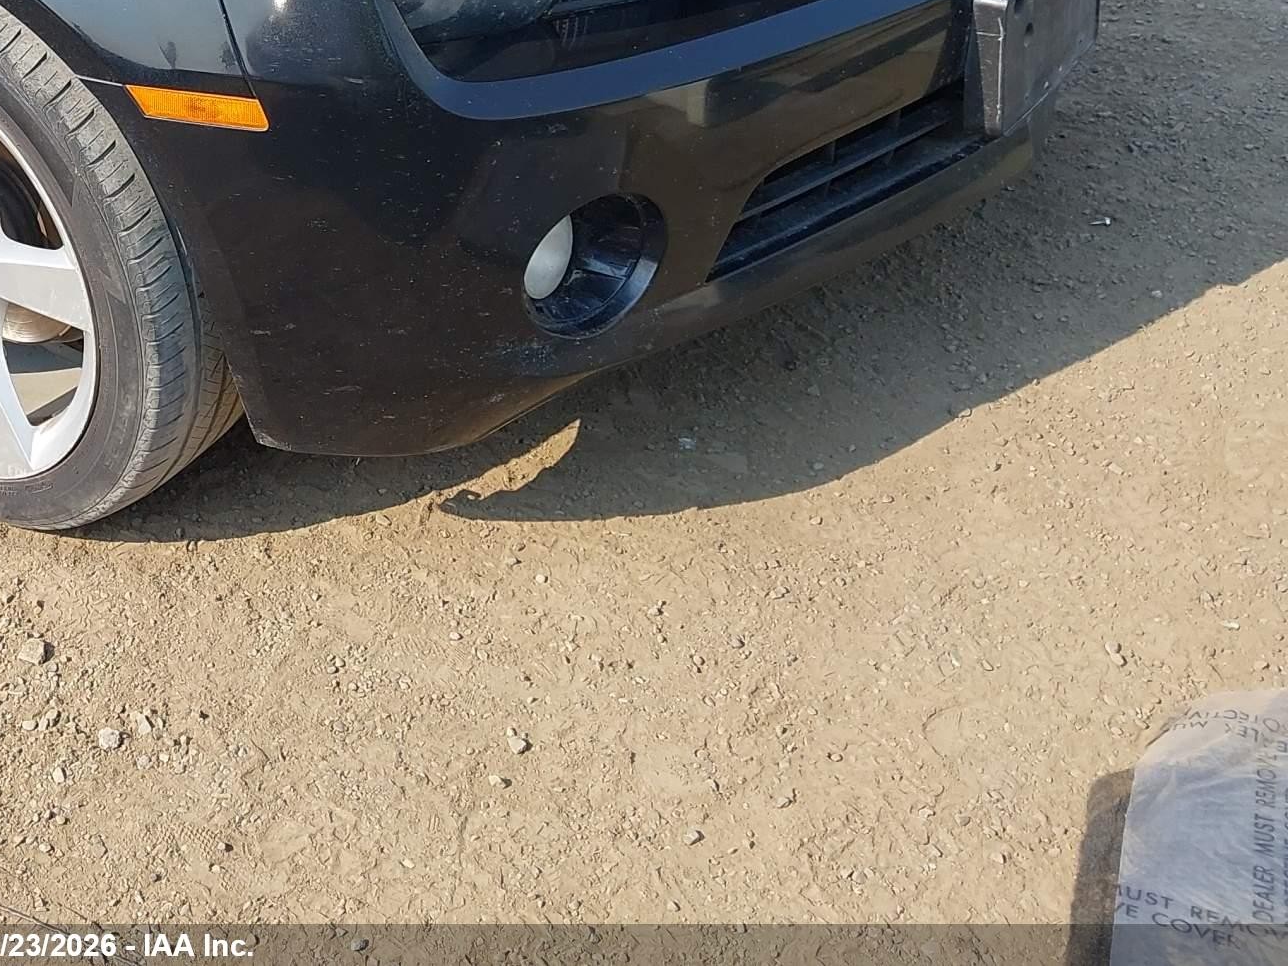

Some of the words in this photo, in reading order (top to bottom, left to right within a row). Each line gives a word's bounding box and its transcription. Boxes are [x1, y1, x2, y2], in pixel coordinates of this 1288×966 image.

[1254, 813, 1276, 857] MUST
[1252, 864, 1275, 923] DEALER
[1151, 912, 1242, 951] COVER
